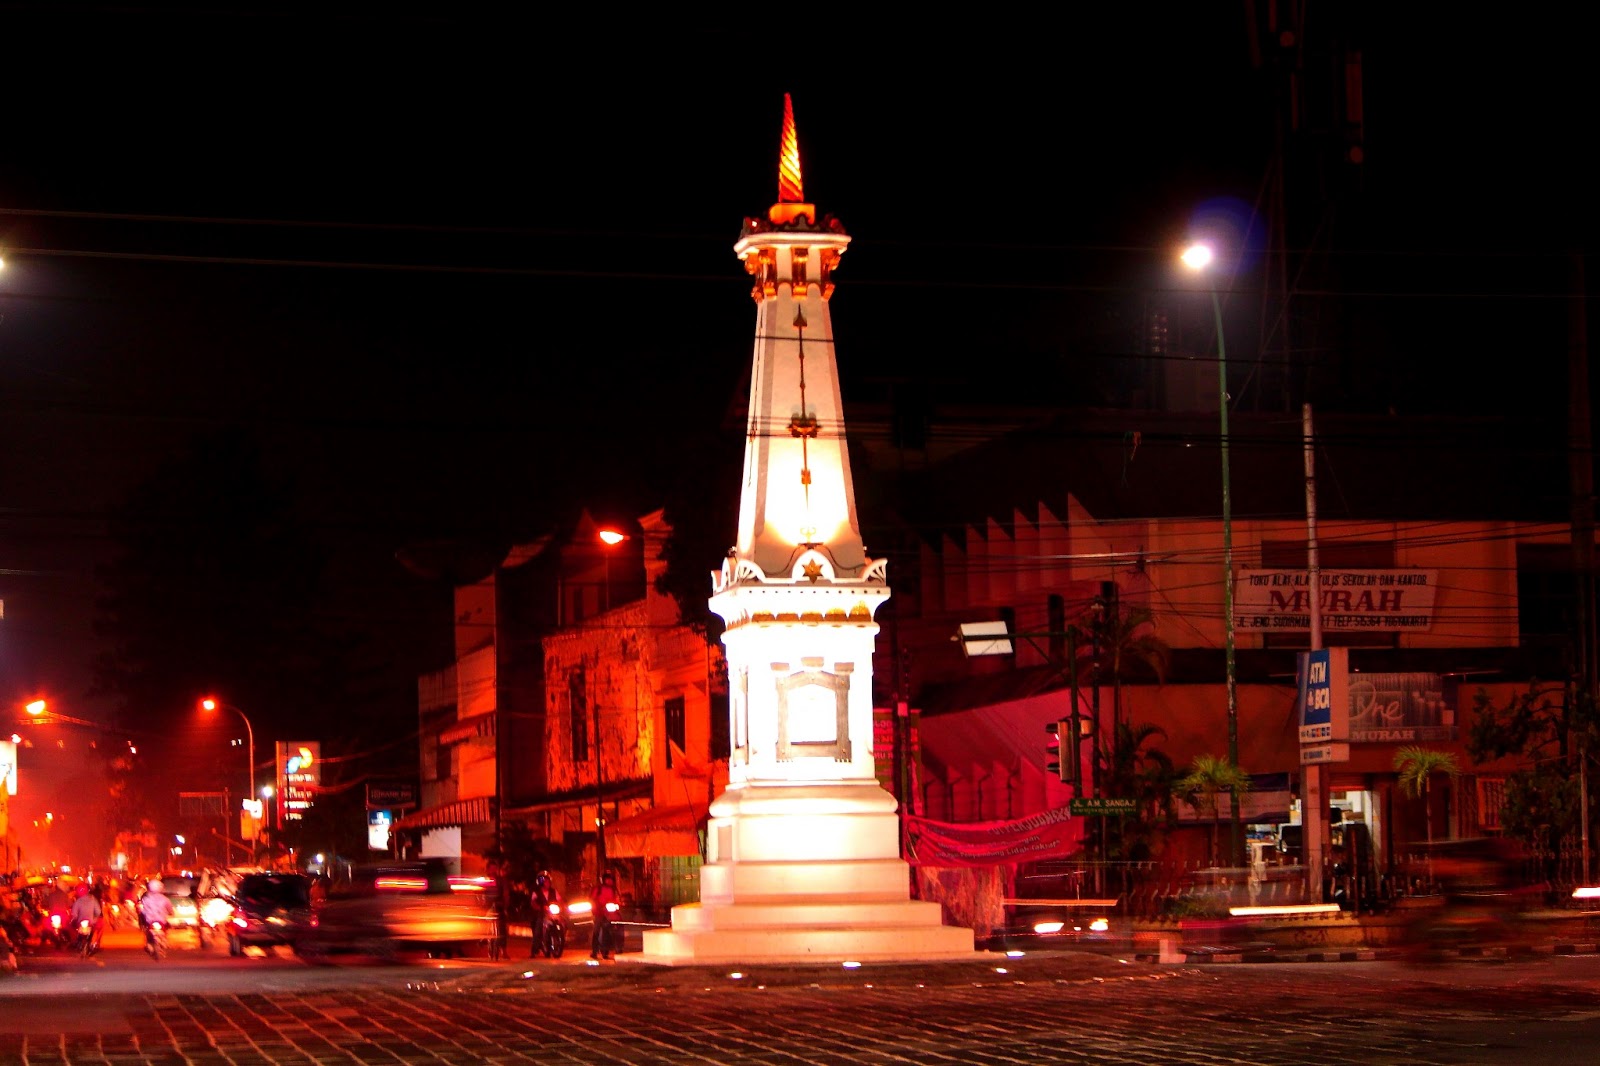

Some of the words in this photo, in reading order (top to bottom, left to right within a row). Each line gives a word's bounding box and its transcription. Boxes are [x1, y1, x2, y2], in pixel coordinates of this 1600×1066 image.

[1250, 575, 1269, 586] TOKO
[1272, 575, 1292, 586] ALAT
[1294, 575, 1309, 586] ALA
[1342, 575, 1376, 586] SEKOLAH
[1379, 575, 1395, 586] DAN
[1268, 590, 1404, 612] MURAH
[1309, 661, 1327, 685] ATM
[1314, 688, 1330, 710] BCA
[1352, 730, 1415, 741] MURAH
